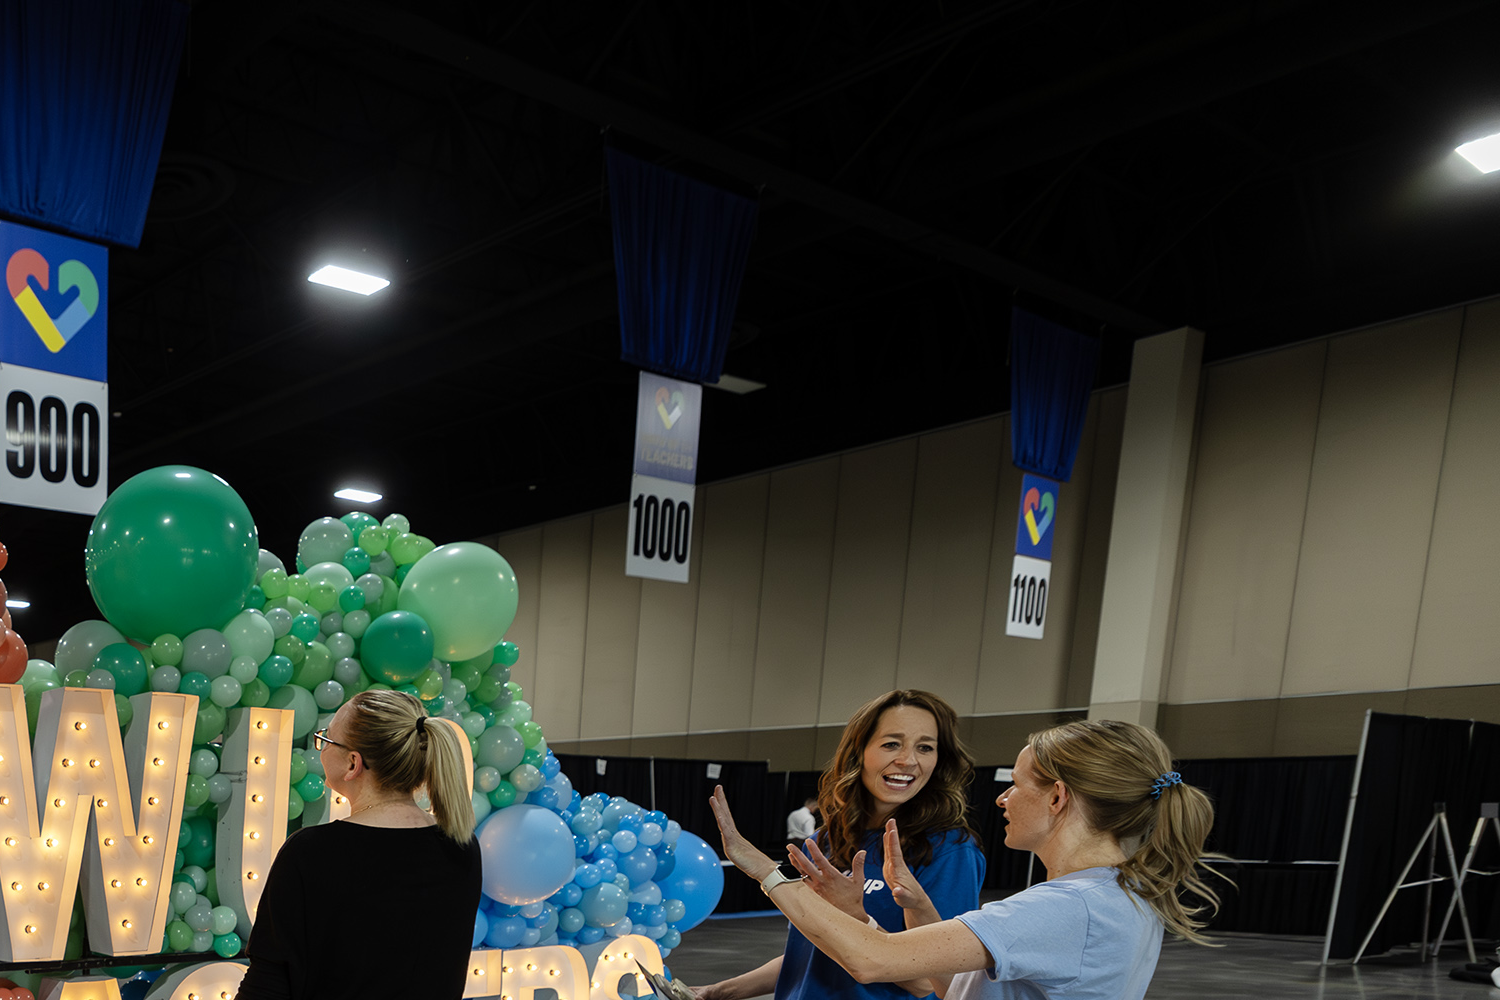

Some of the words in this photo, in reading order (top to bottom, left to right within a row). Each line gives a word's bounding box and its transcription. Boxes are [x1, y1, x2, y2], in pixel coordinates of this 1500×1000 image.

[6, 390, 100, 488] 900
[632, 493, 691, 565] 1000
[1011, 573, 1047, 627] 1100
